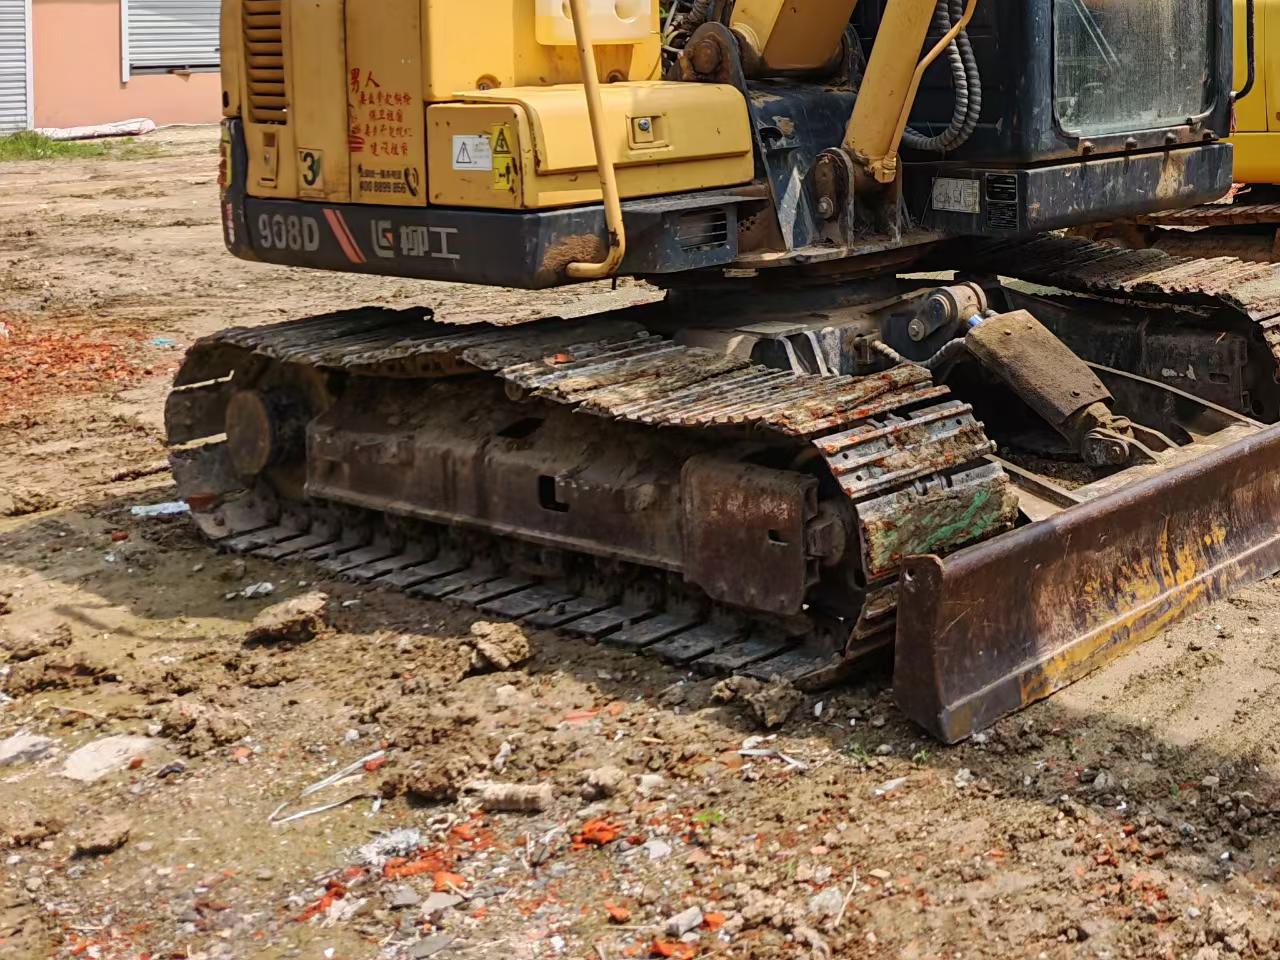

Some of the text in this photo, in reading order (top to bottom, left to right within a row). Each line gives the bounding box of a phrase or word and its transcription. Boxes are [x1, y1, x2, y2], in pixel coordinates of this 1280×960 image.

[350, 67, 380, 95] 男人
[302, 151, 317, 186] 3
[258, 213, 320, 252] 908D
[400, 225, 461, 260] 柳工
